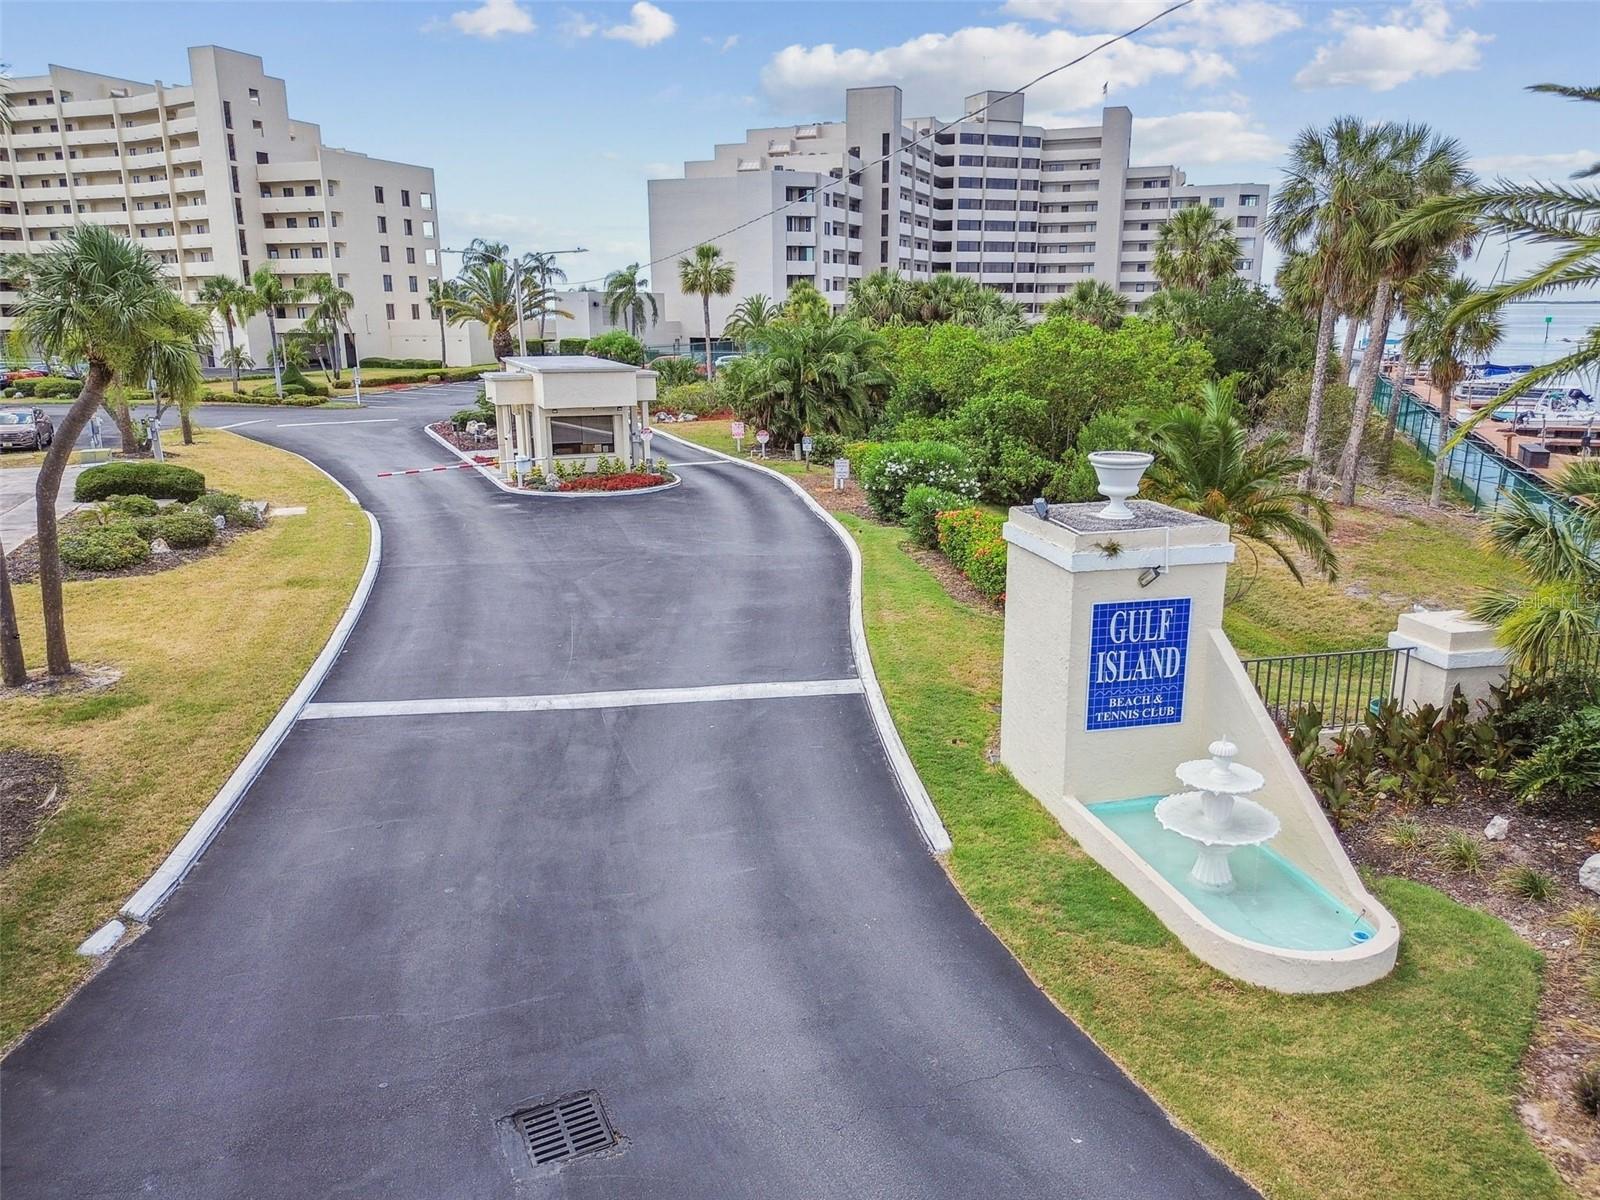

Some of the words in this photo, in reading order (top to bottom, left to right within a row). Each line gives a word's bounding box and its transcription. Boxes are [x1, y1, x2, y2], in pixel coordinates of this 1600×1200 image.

[1110, 608, 1174, 643] GULF
[1096, 647, 1181, 683] ISLAND
[1109, 695, 1150, 707] BEACH
[1153, 694, 1163, 703] &
[1096, 709, 1139, 721] TENNIS
[1142, 707, 1175, 718] CLUB
